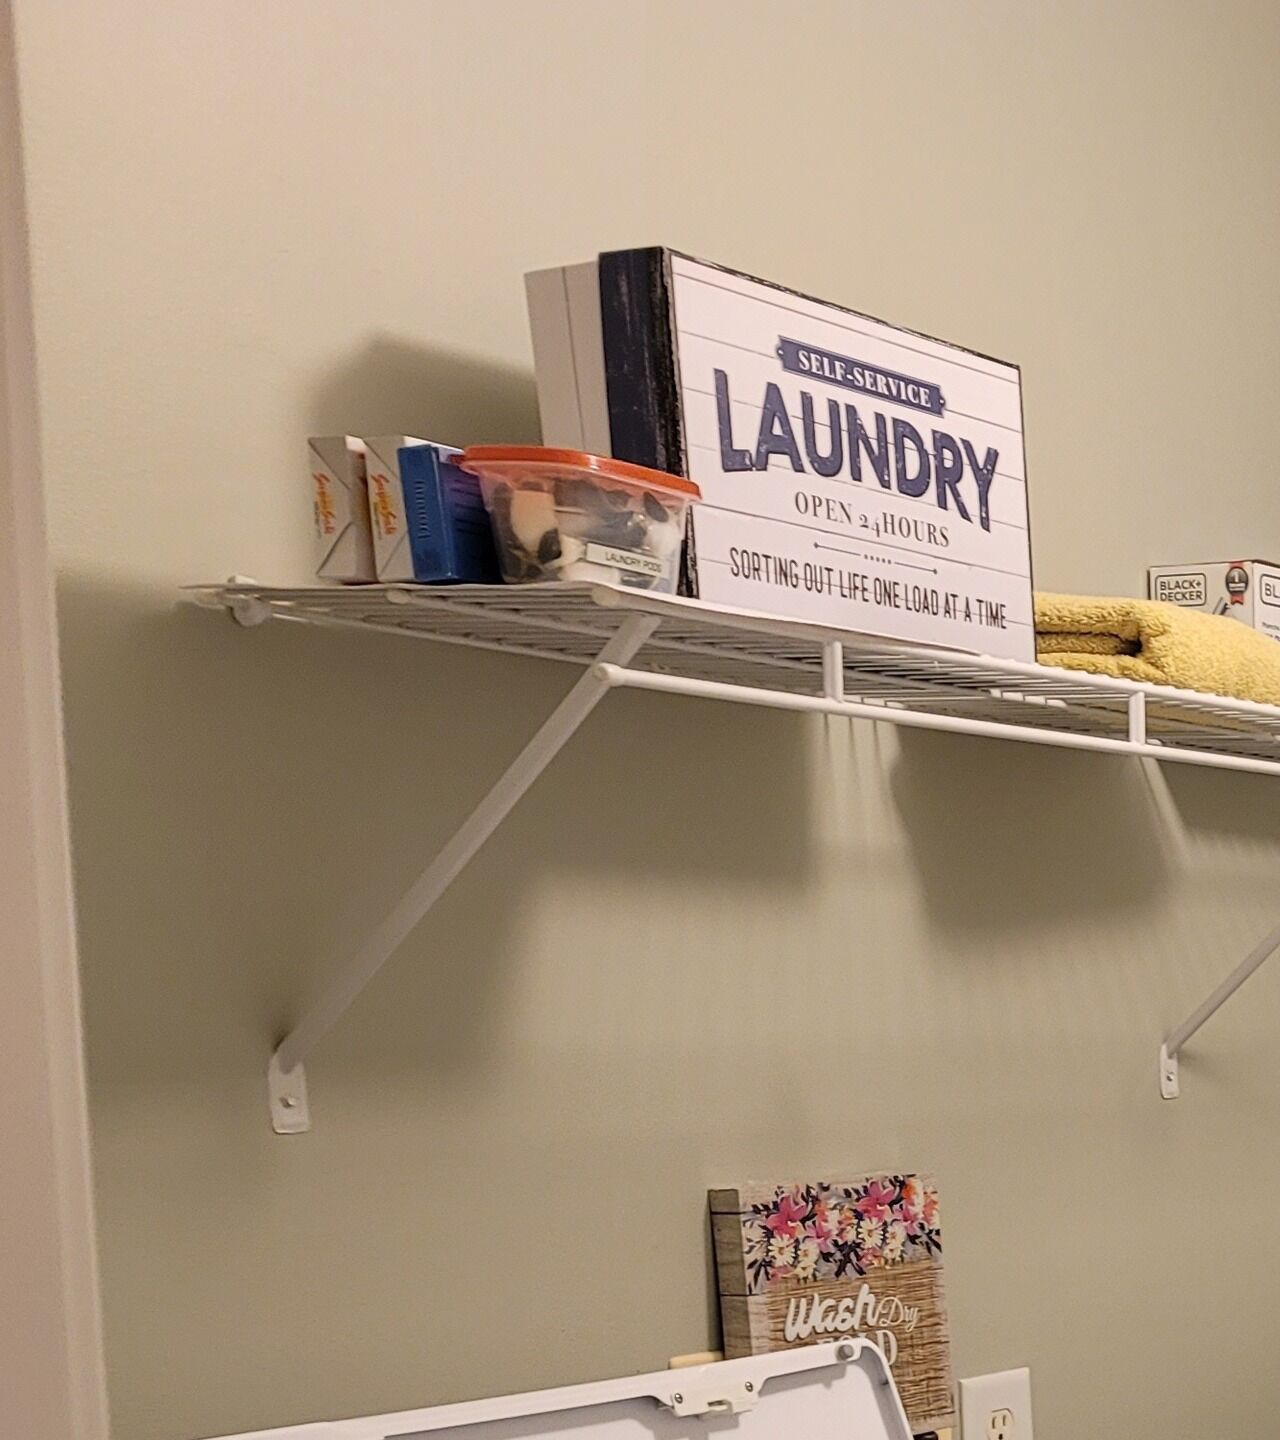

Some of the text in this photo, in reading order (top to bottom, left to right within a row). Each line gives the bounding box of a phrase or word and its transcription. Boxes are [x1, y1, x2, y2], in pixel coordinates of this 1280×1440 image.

[799, 349, 931, 408] SELF-SERVICE
[714, 368, 999, 532] LAUNDRY
[795, 491, 852, 525] OPEN
[605, 552, 642, 570] LAUNDRY
[730, 547, 1007, 630] SORTING OUT LIFE ONE LOAD AT A TIME
[1160, 591, 1202, 602] DECKER
[784, 1284, 919, 1342] Wash Dry
